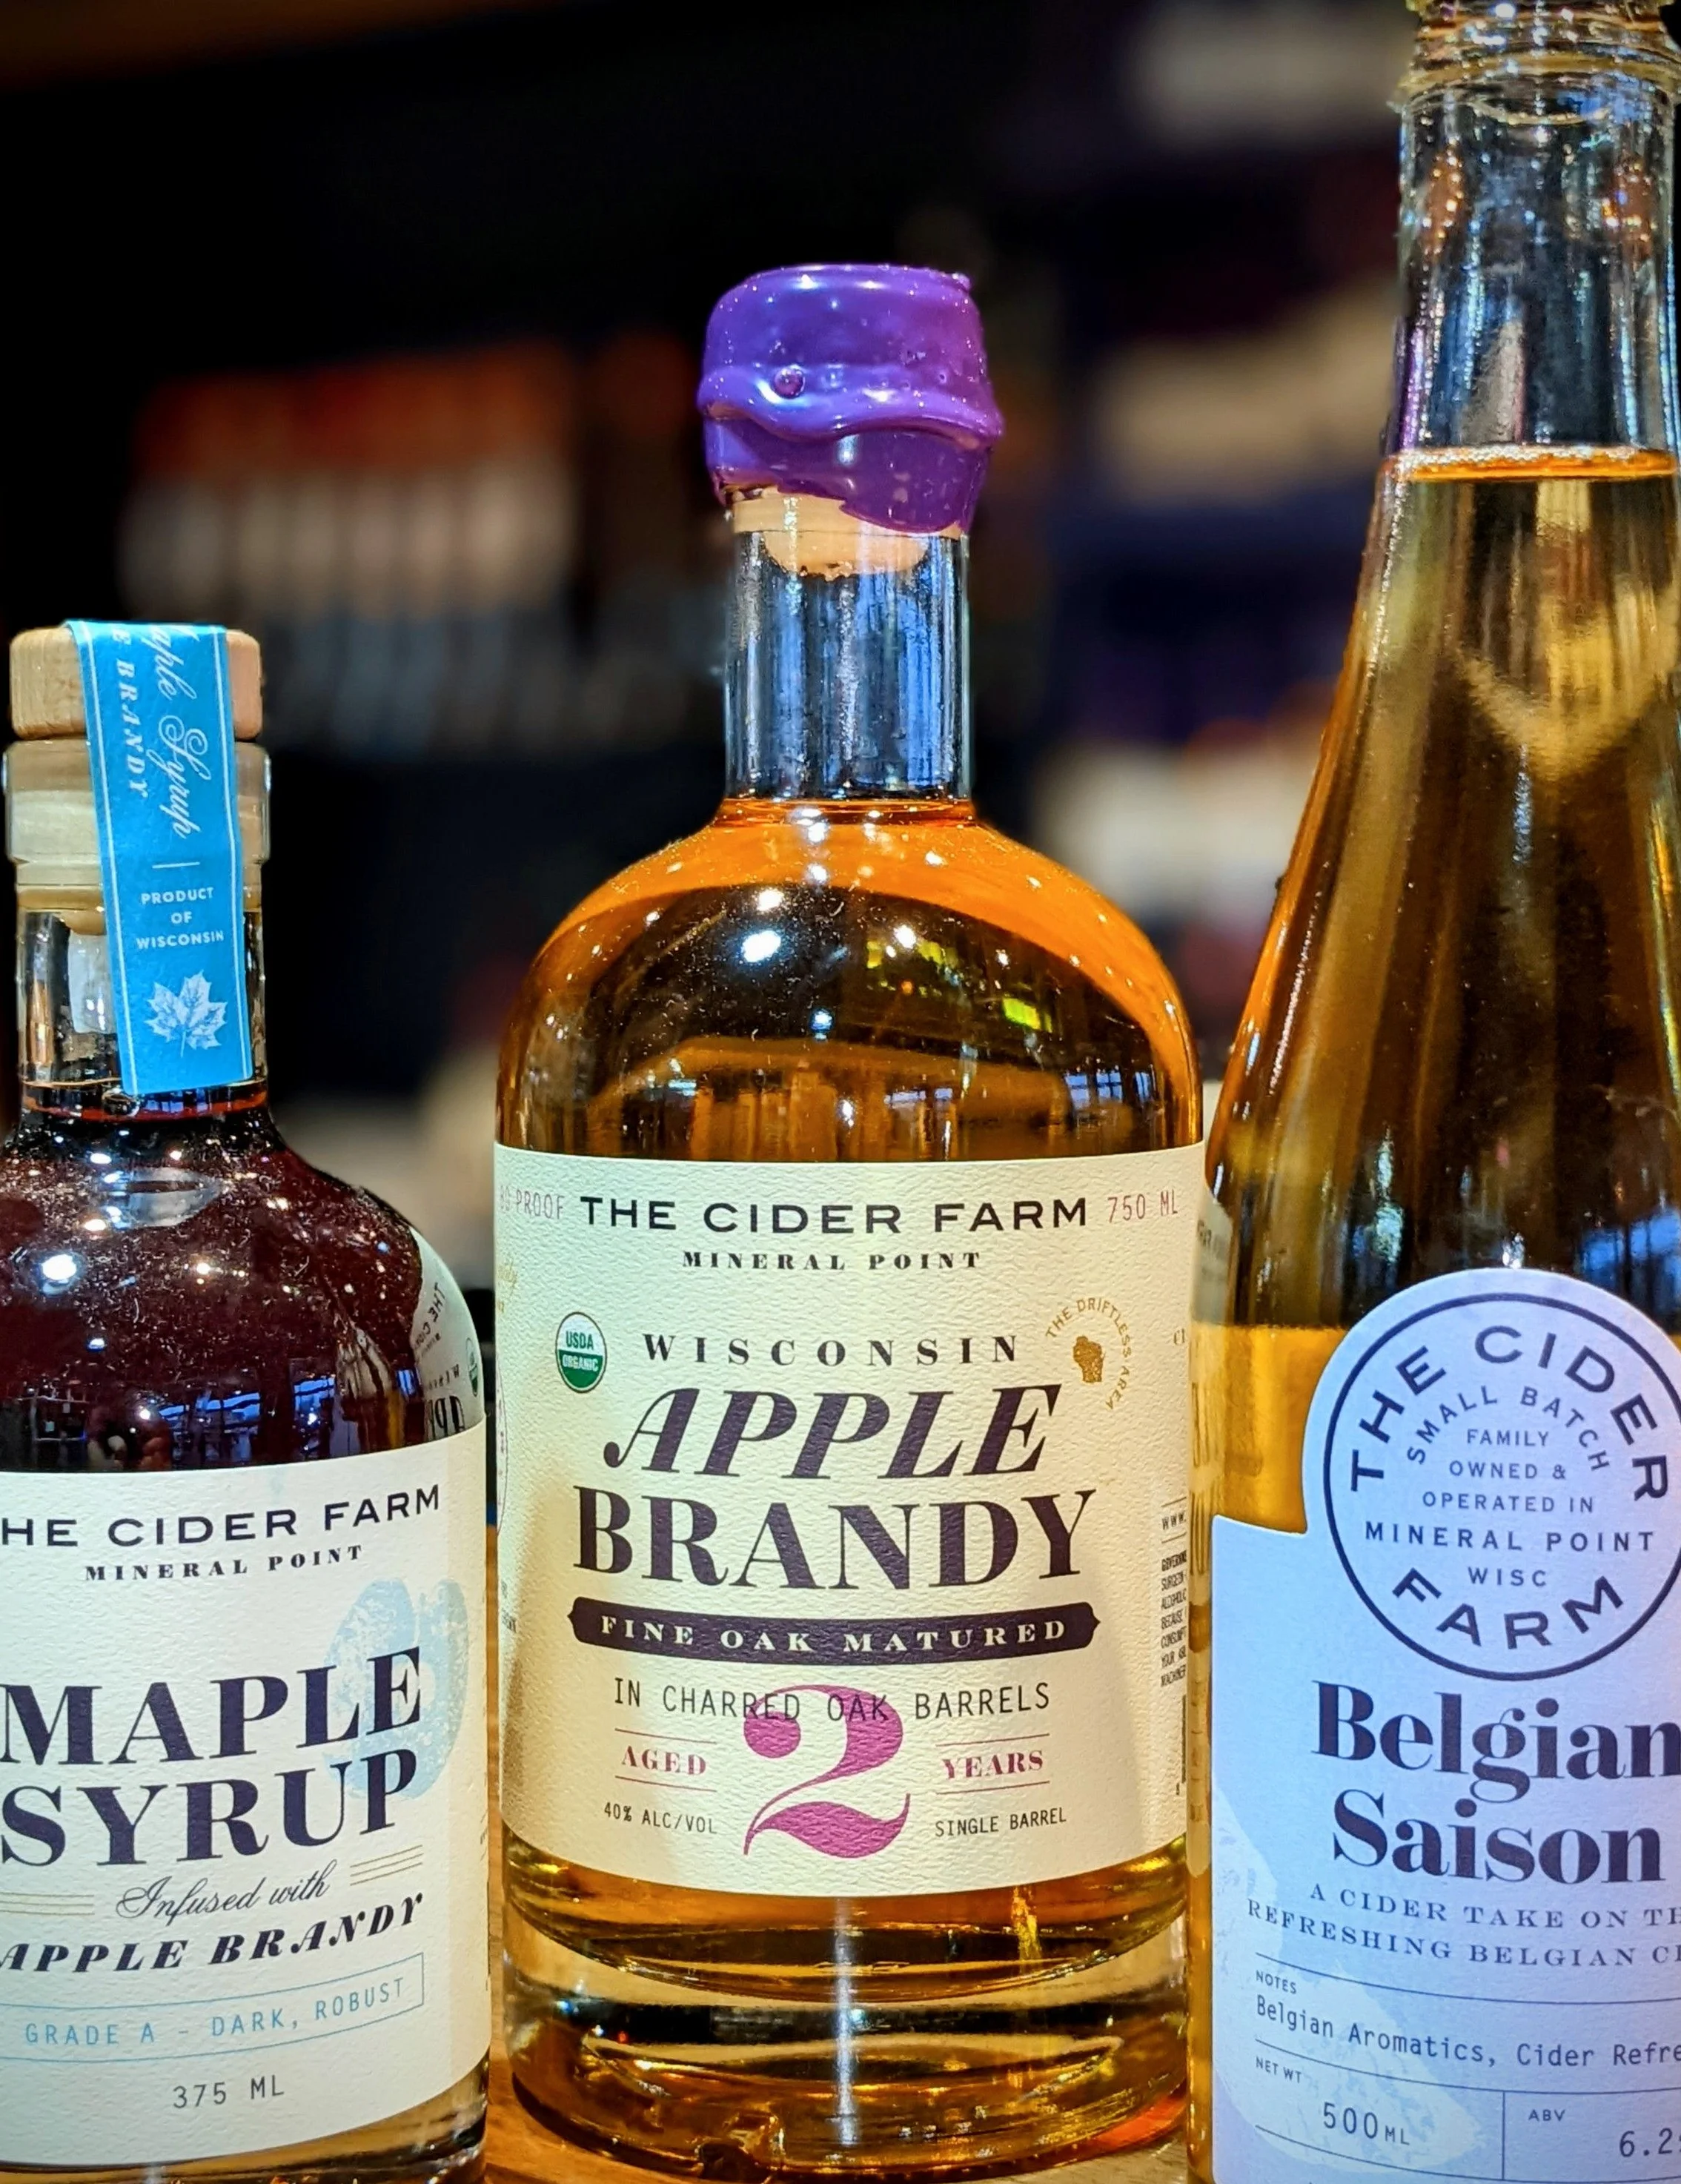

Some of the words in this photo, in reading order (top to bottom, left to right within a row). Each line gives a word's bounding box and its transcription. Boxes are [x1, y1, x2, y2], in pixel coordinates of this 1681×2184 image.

[116, 658, 148, 800] BRANDY
[146, 715, 212, 840] Syrup
[141, 887, 214, 906] PRODUCT
[170, 910, 193, 925] OF
[135, 930, 225, 950] WISCONSIN
[516, 1189, 566, 1220] PROOF
[580, 1196, 676, 1231] THE
[703, 1202, 901, 1234] CIDER
[935, 1197, 1087, 1232] FARM
[1107, 1194, 1146, 1223] 750
[1160, 1189, 1179, 1217] ML
[683, 1251, 846, 1270] MINERAL
[868, 1251, 980, 1270] POINT
[566, 1331, 594, 1350] USDA
[643, 1334, 1016, 1367] WISCONSIN
[1045, 1306, 1072, 1338] THE
[1076, 1297, 1132, 1358] DRIFTLESS
[1105, 1366, 1130, 1409] AREA
[563, 1354, 599, 1372] ORGANIC
[603, 1383, 1062, 1480] APPLE
[1351, 1346, 1447, 1492] THE
[1408, 1385, 1498, 1464] SMALL
[1520, 1386, 1611, 1472] BATCH
[1475, 1325, 1668, 1502] CIDER
[1467, 1429, 1551, 1448] FAMILY
[1449, 1460, 1538, 1480] OWNED
[1552, 1465, 1566, 1480] &
[1, 1517, 78, 1547] HE
[107, 1509, 297, 1547] CIDER
[324, 1483, 440, 1531] FARM
[1422, 1491, 1555, 1513] OPERATED
[1570, 1497, 1594, 1513] IN
[573, 1485, 1097, 1591] BRANDY
[1365, 1521, 1522, 1551] MINERAL
[1546, 1532, 1654, 1552] POINT
[85, 1558, 248, 1581] MINERAL
[268, 1544, 363, 1572] POINT
[1468, 1566, 1548, 1588] WISC
[1392, 1566, 1623, 1649] FARM
[601, 1615, 694, 1646] FINE
[720, 1631, 820, 1653] OAK
[844, 1620, 1067, 1654] MATURED
[0, 1646, 422, 1765] MAPLE
[614, 1678, 641, 1707] IN
[662, 1684, 800, 1721] CHARRED
[826, 1693, 890, 1723] OAK
[915, 1682, 1051, 1720] BARRELS
[621, 1744, 707, 1776] AGED
[1310, 1680, 1681, 1804] Belgian
[743, 1684, 912, 1859] 2
[942, 1750, 1044, 1780] YEARS
[0, 1749, 417, 1867] SYRUP
[604, 1801, 632, 1823] 40%
[642, 1808, 717, 1835] ALC/VOL
[935, 1816, 999, 1838] SINGLE
[1009, 1807, 1067, 1831] BARREL
[1333, 1789, 1667, 1884] Saison
[115, 1876, 262, 1925] Infused
[269, 1859, 338, 1905] with
[1310, 1883, 1326, 1902] A
[1340, 1889, 1448, 1922] CIDER
[1463, 1906, 1564, 1927] TAKE
[1580, 1910, 1628, 1928] ON
[1643, 1907, 1681, 1926] TH
[0, 1939, 188, 1973] APPLE
[208, 1893, 423, 1965] BRANDY
[1247, 1899, 1452, 1959] REFRESHING
[1468, 1945, 1636, 1967] BELGIAN
[1255, 1970, 1297, 1995] NOTES
[25, 2022, 119, 2045] GRADE
[140, 2022, 155, 2044] A
[212, 2008, 299, 2038] DARK,
[315, 1978, 405, 2020] ROBUST
[1256, 1995, 1334, 2039] Belgian
[1347, 2023, 1496, 2068] Aromatics,
[1516, 2042, 1594, 2067] Cider
[1613, 2041, 1681, 2065] Refre
[1255, 2056, 1279, 2077] NET
[1284, 2067, 1302, 2084] WT
[173, 2082, 228, 2109] 375
[251, 2075, 285, 2100] ML
[1528, 2108, 1565, 2122] ABV
[1619, 2127, 1681, 2158] 6.2
